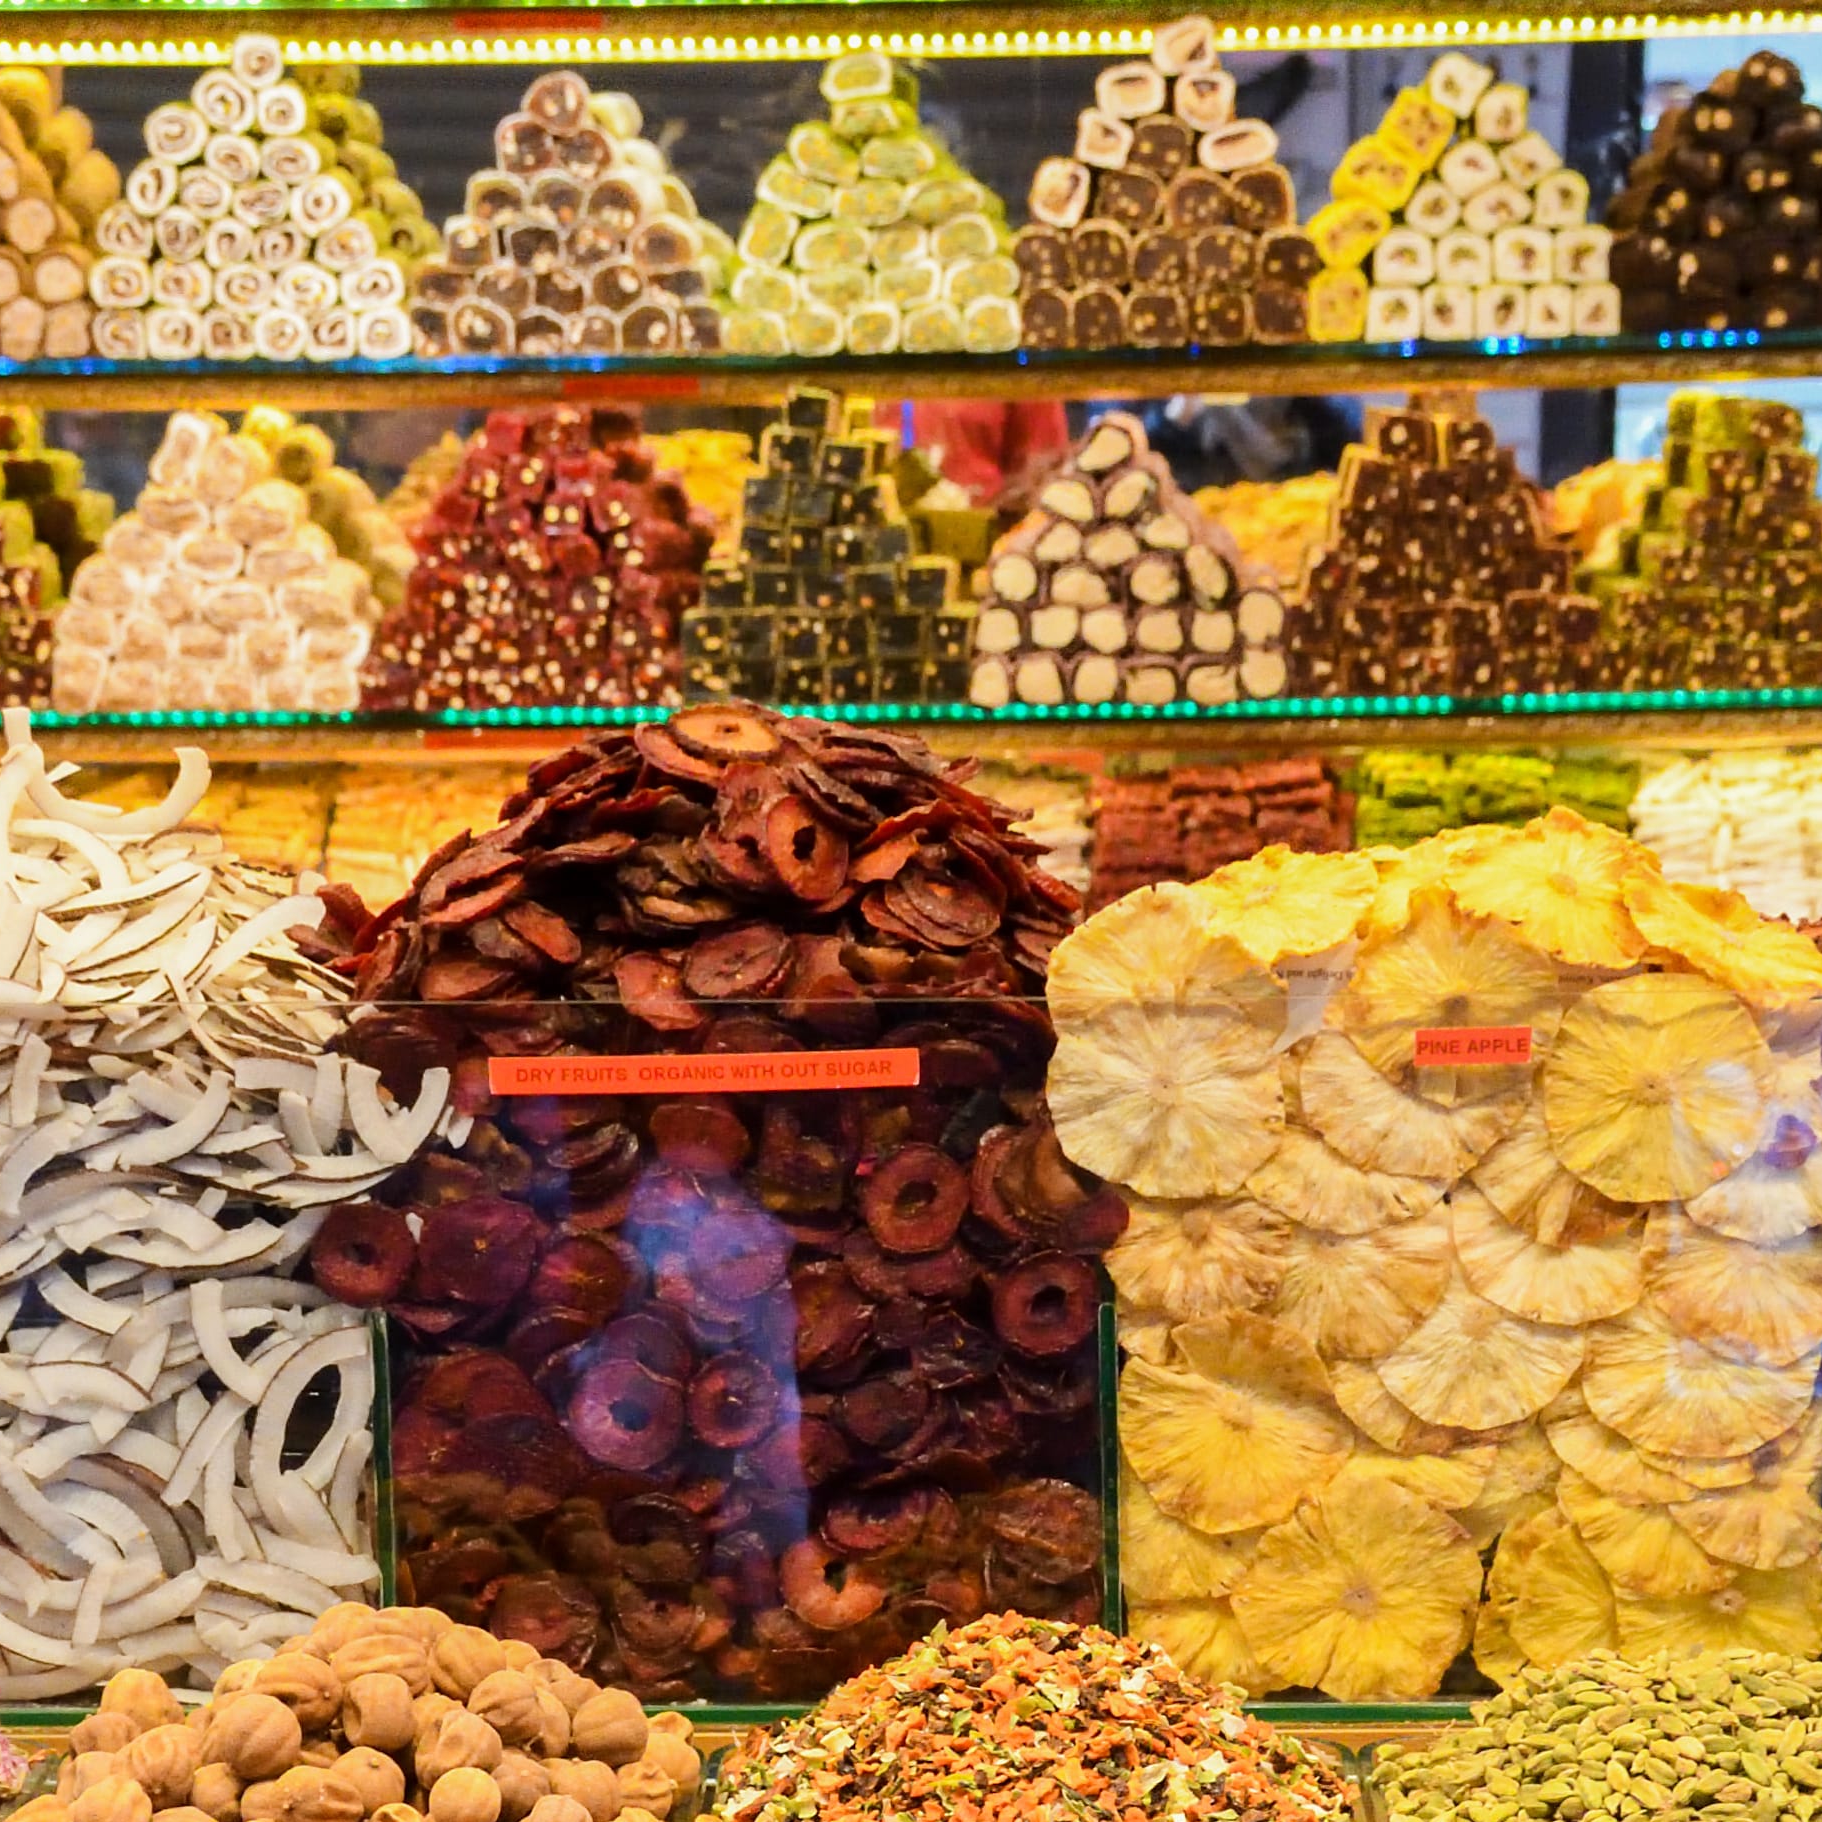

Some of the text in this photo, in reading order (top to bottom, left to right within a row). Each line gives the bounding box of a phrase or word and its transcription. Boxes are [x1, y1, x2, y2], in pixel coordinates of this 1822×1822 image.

[1416, 1038, 1528, 1055] PINE APPLE
[516, 1060, 893, 1083] DRY FRUITS ORGANIC WITH OUT SUGAR
